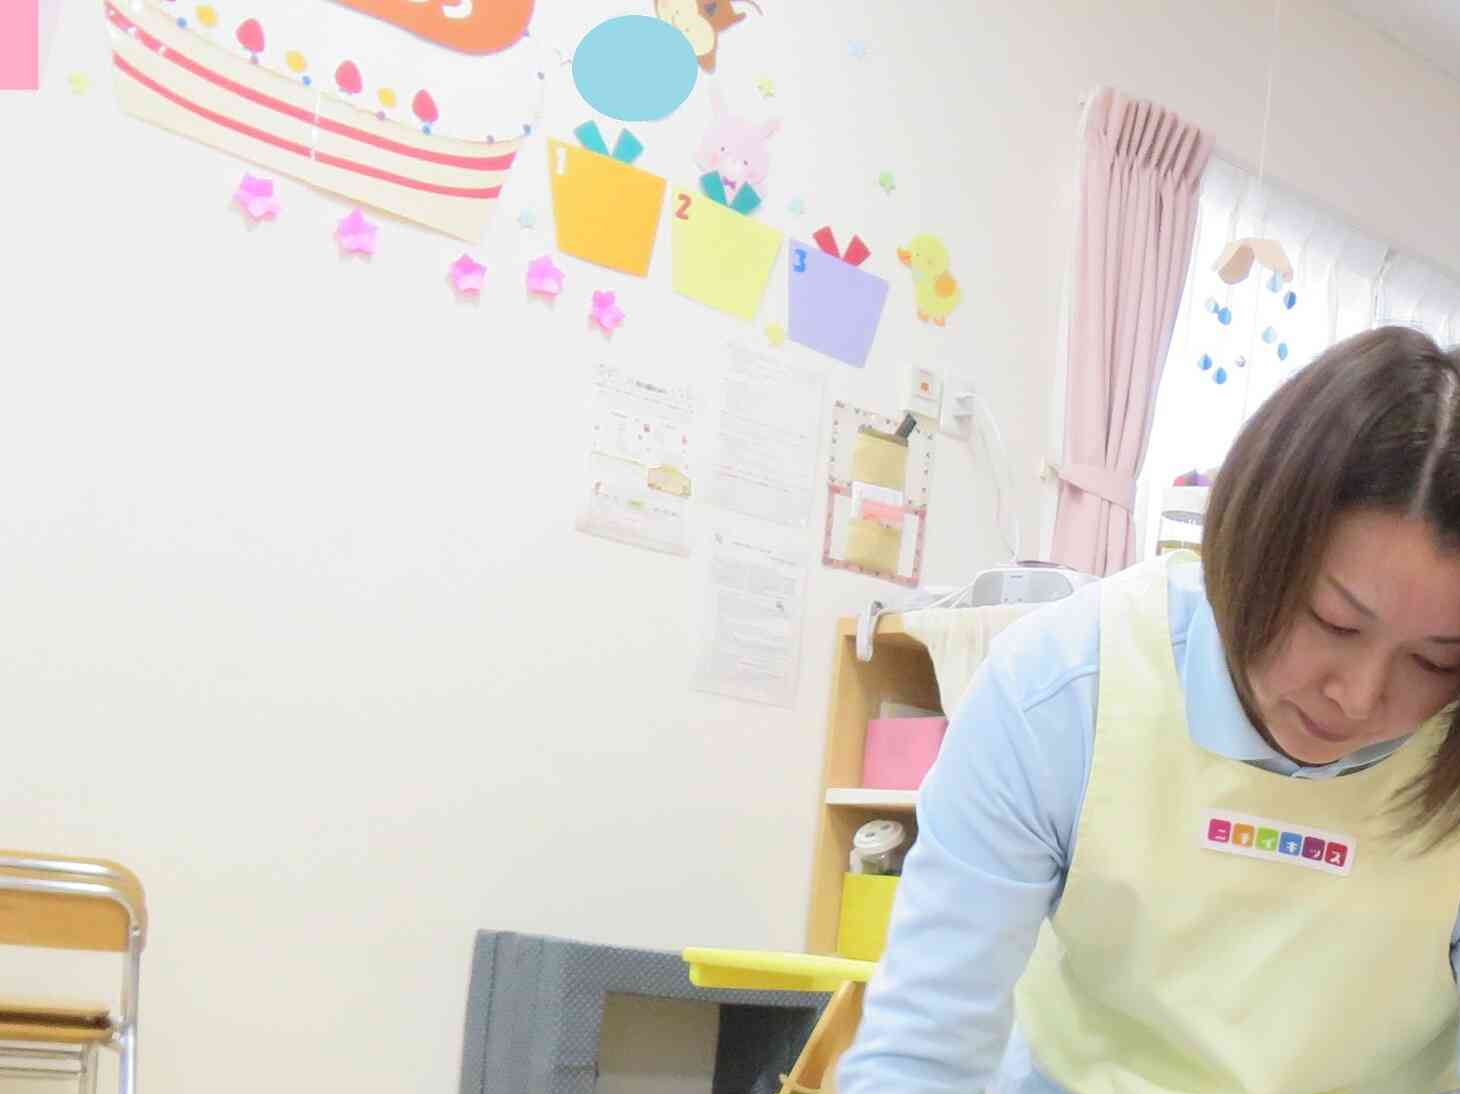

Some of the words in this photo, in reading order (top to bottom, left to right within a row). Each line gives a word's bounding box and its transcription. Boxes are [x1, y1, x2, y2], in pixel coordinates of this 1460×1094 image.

[555, 147, 567, 175] 1
[675, 193, 692, 220] 2
[793, 248, 808, 274] 3
